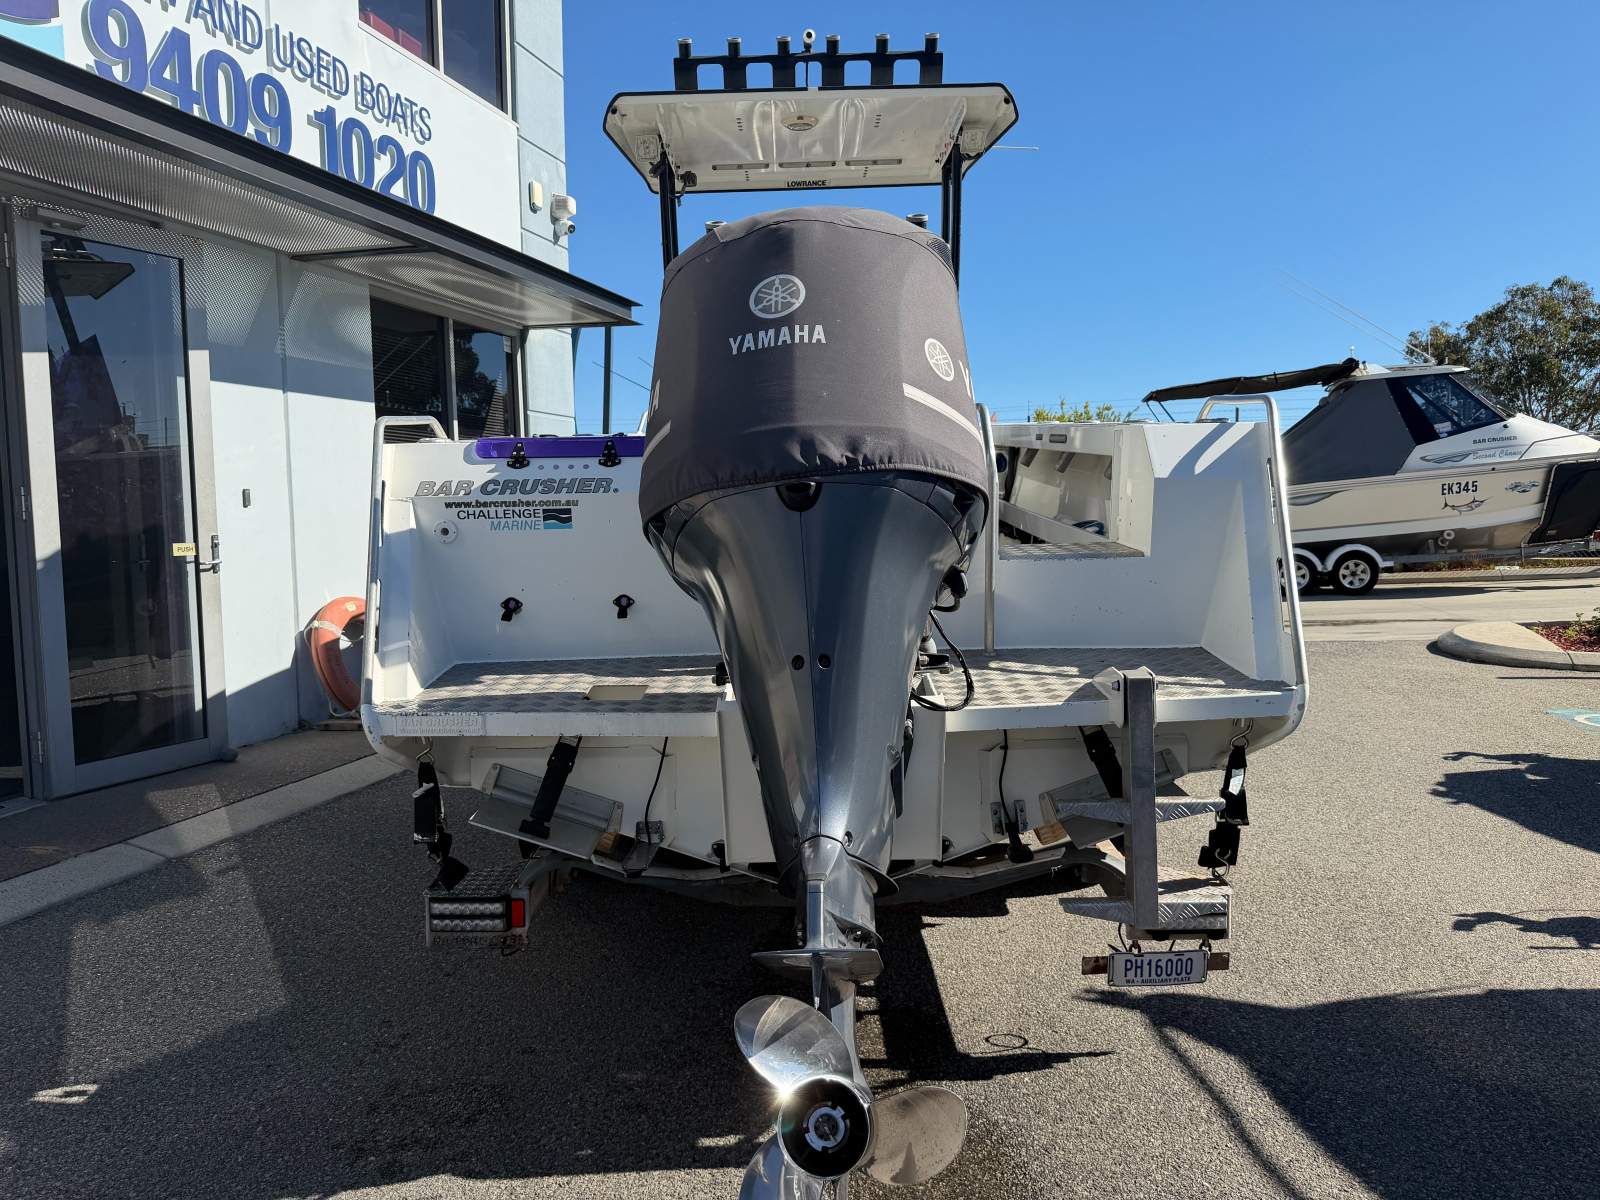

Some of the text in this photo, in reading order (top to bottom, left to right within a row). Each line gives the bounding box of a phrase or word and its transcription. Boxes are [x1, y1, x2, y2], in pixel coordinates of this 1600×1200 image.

[193, 0, 432, 142] AND USED BOATS
[88, 0, 436, 216] 9409 1020
[786, 179, 828, 188] LOWRANCE
[728, 324, 827, 355] YAMAHA
[415, 479, 475, 497] BAR
[1441, 480, 1478, 496] EK345
[444, 499, 579, 509] www.barcrusher.com.au
[457, 508, 541, 520] CHALLENGE
[489, 520, 541, 531] MARINE
[1124, 957, 1193, 978] PH16000
